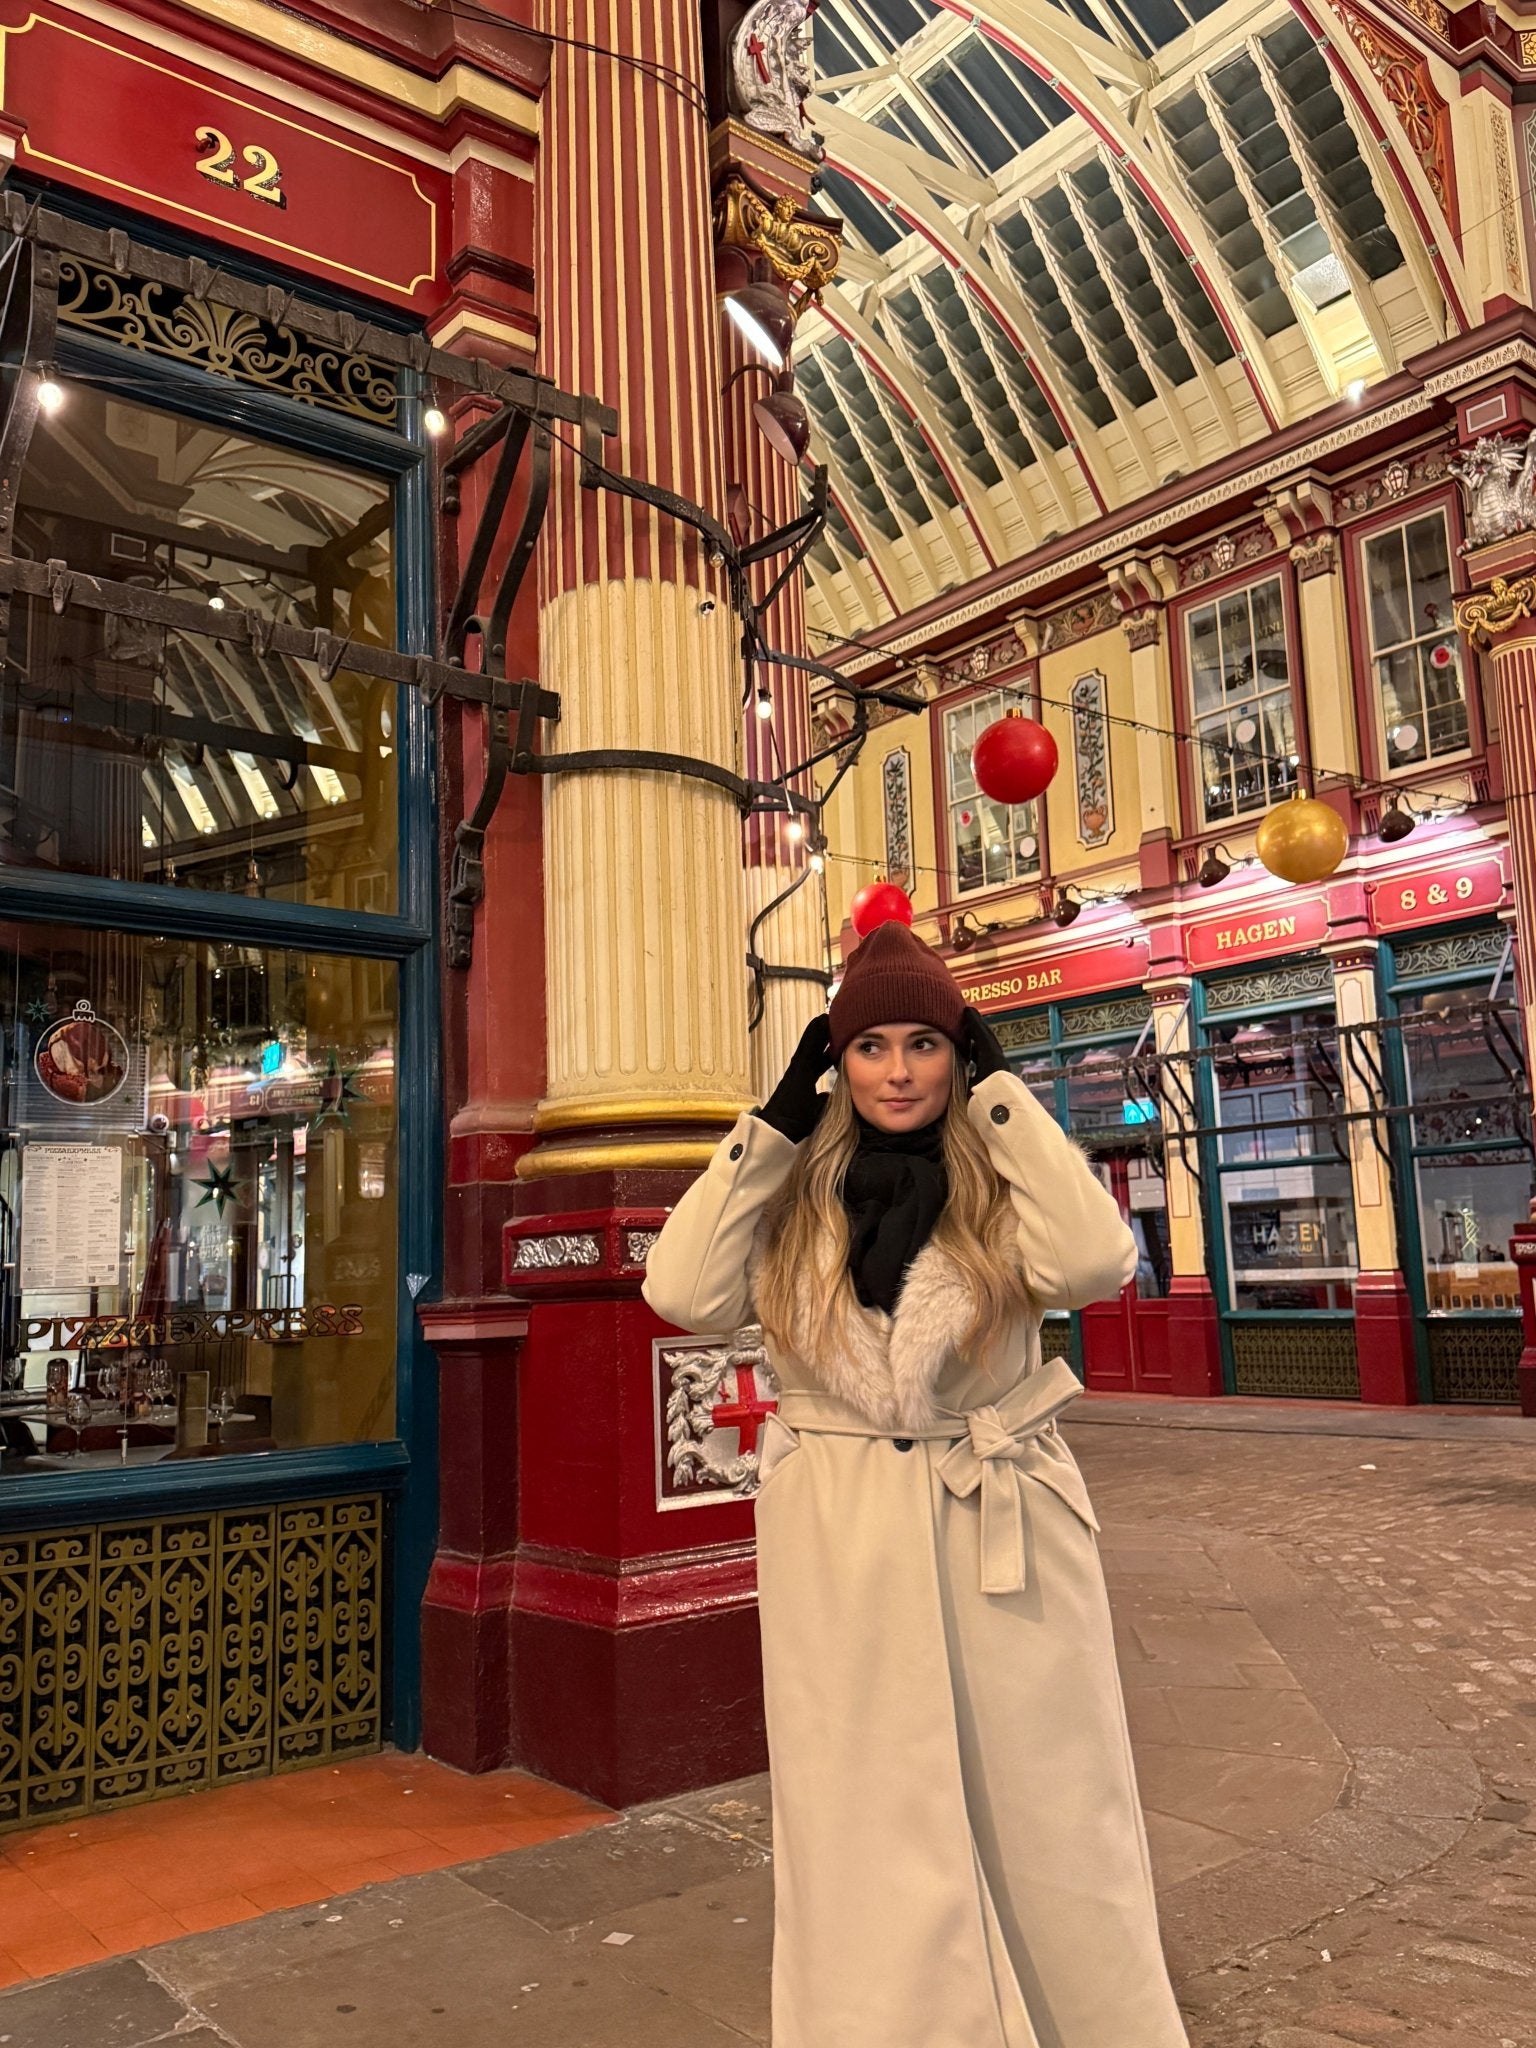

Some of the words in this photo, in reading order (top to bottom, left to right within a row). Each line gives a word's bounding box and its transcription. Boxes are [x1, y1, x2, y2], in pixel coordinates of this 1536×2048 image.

[195, 126, 286, 209] 22
[1400, 889, 1417, 910] 8
[1427, 883, 1449, 906] &
[1455, 876, 1474, 899] 9
[1216, 915, 1297, 950] HAGEN
[1027, 968, 1062, 991] BAR
[17, 1304, 364, 1352] PIZZAEXPRESS
